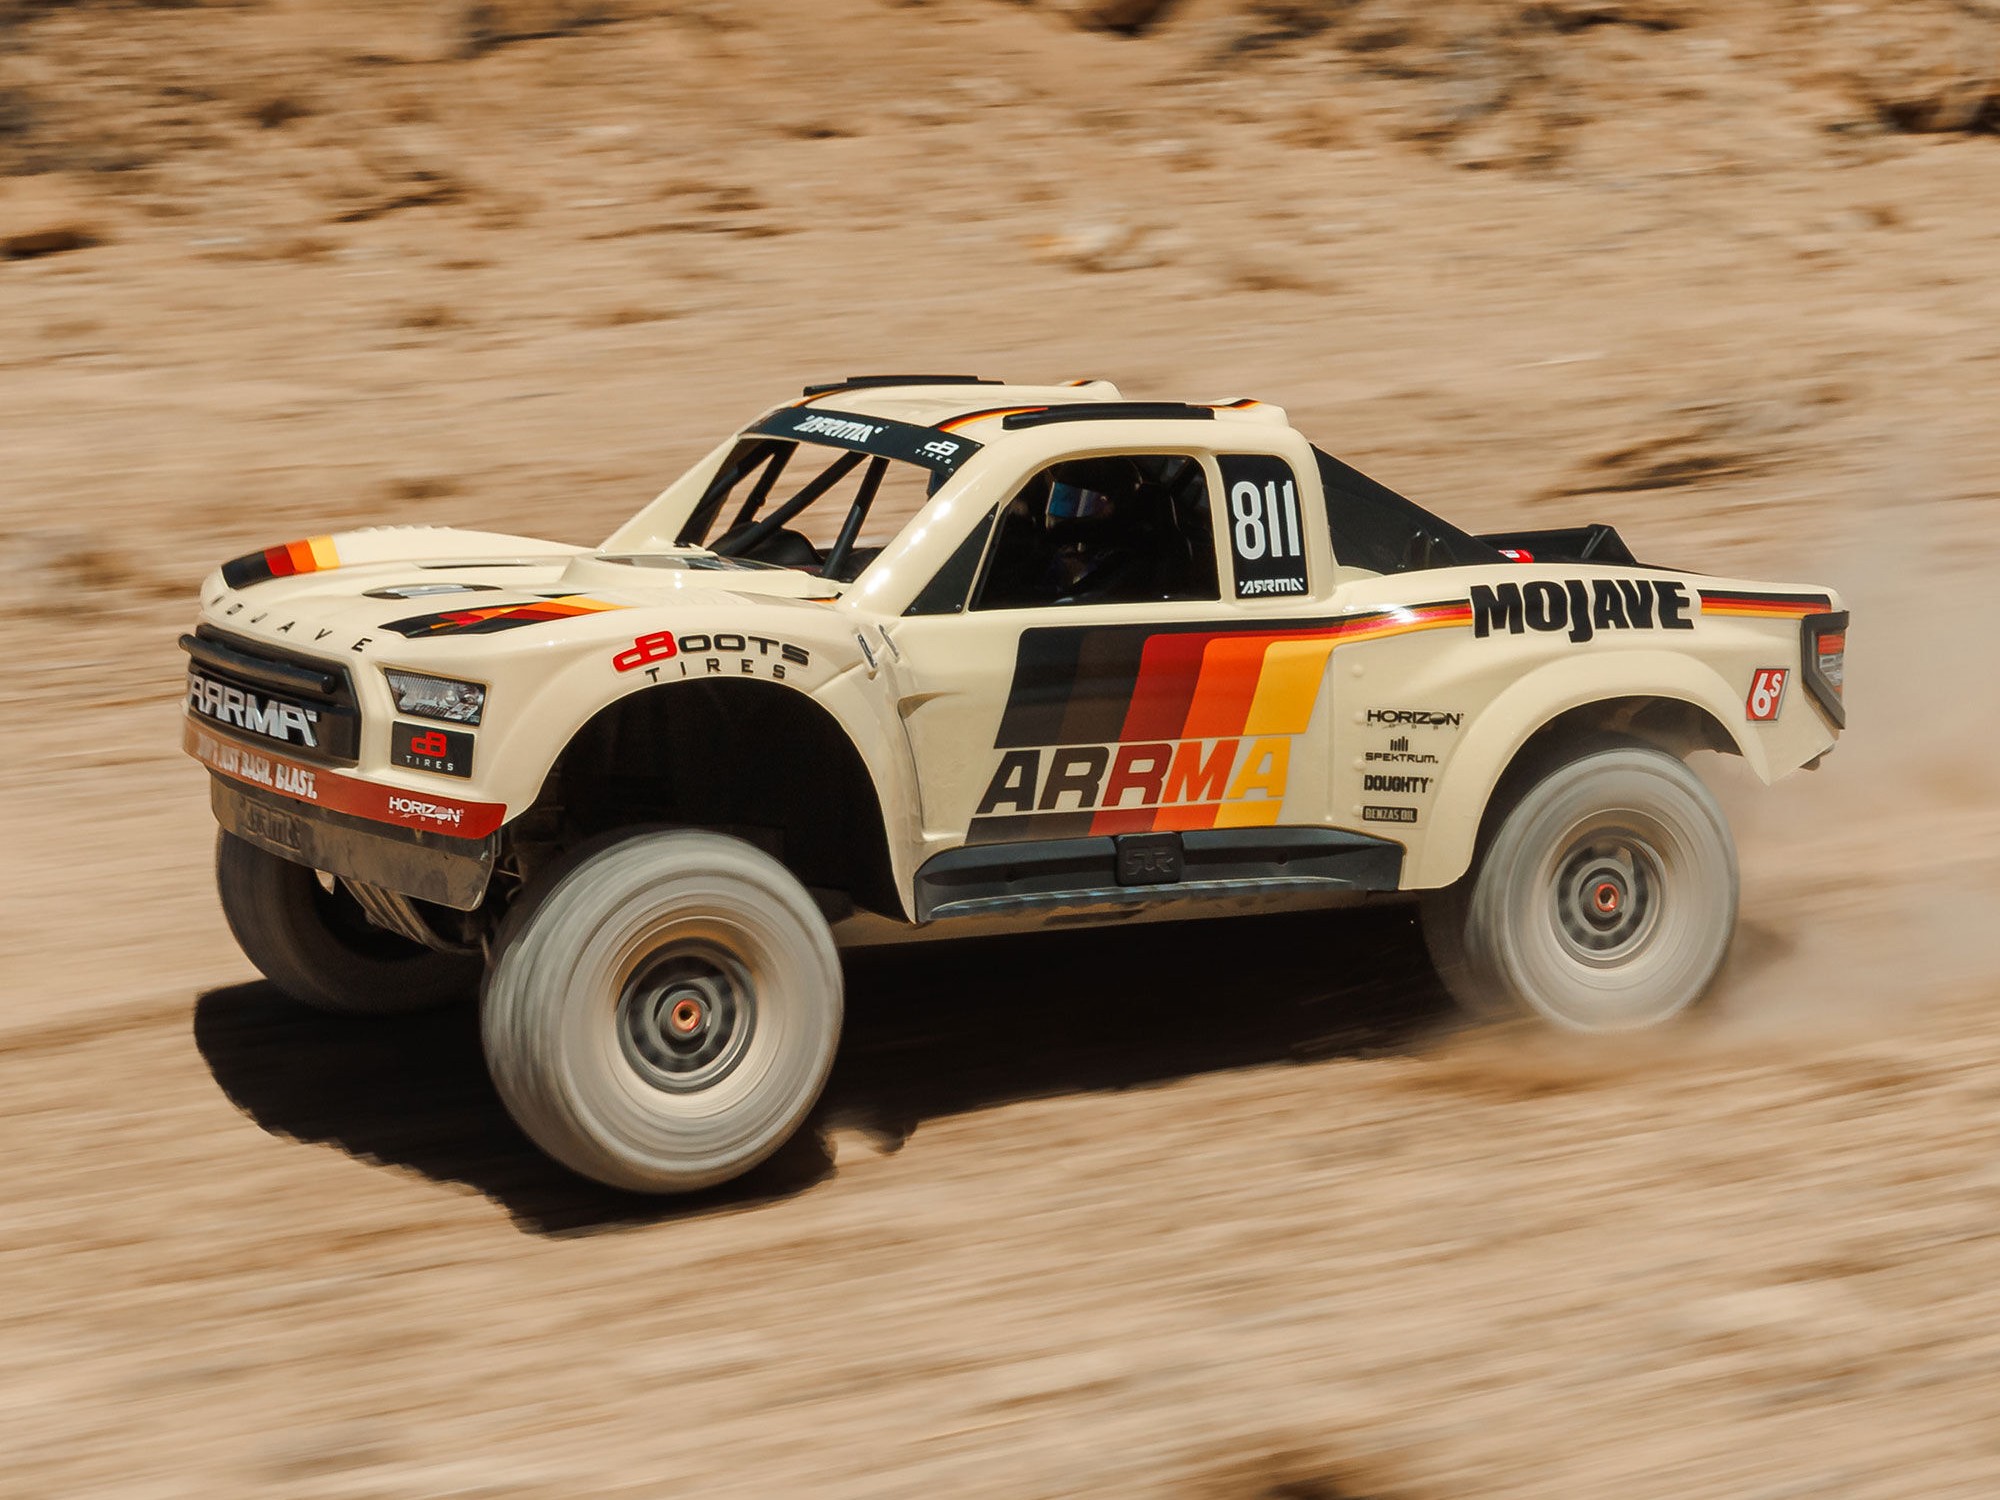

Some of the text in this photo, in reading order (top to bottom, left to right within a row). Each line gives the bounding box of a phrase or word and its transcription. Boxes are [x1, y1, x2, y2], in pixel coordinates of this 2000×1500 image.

[914, 448, 953, 465] TIRES
[1231, 480, 1301, 560] 811
[1470, 579, 1695, 643] MOJAVE
[645, 657, 786, 684] TIRES
[1366, 709, 1461, 726] HORIZON
[405, 755, 455, 771] TIRES
[975, 736, 1291, 815] ARRMA
[1364, 774, 1430, 794] DOUGHTY
[388, 795, 461, 823] HORIZON
